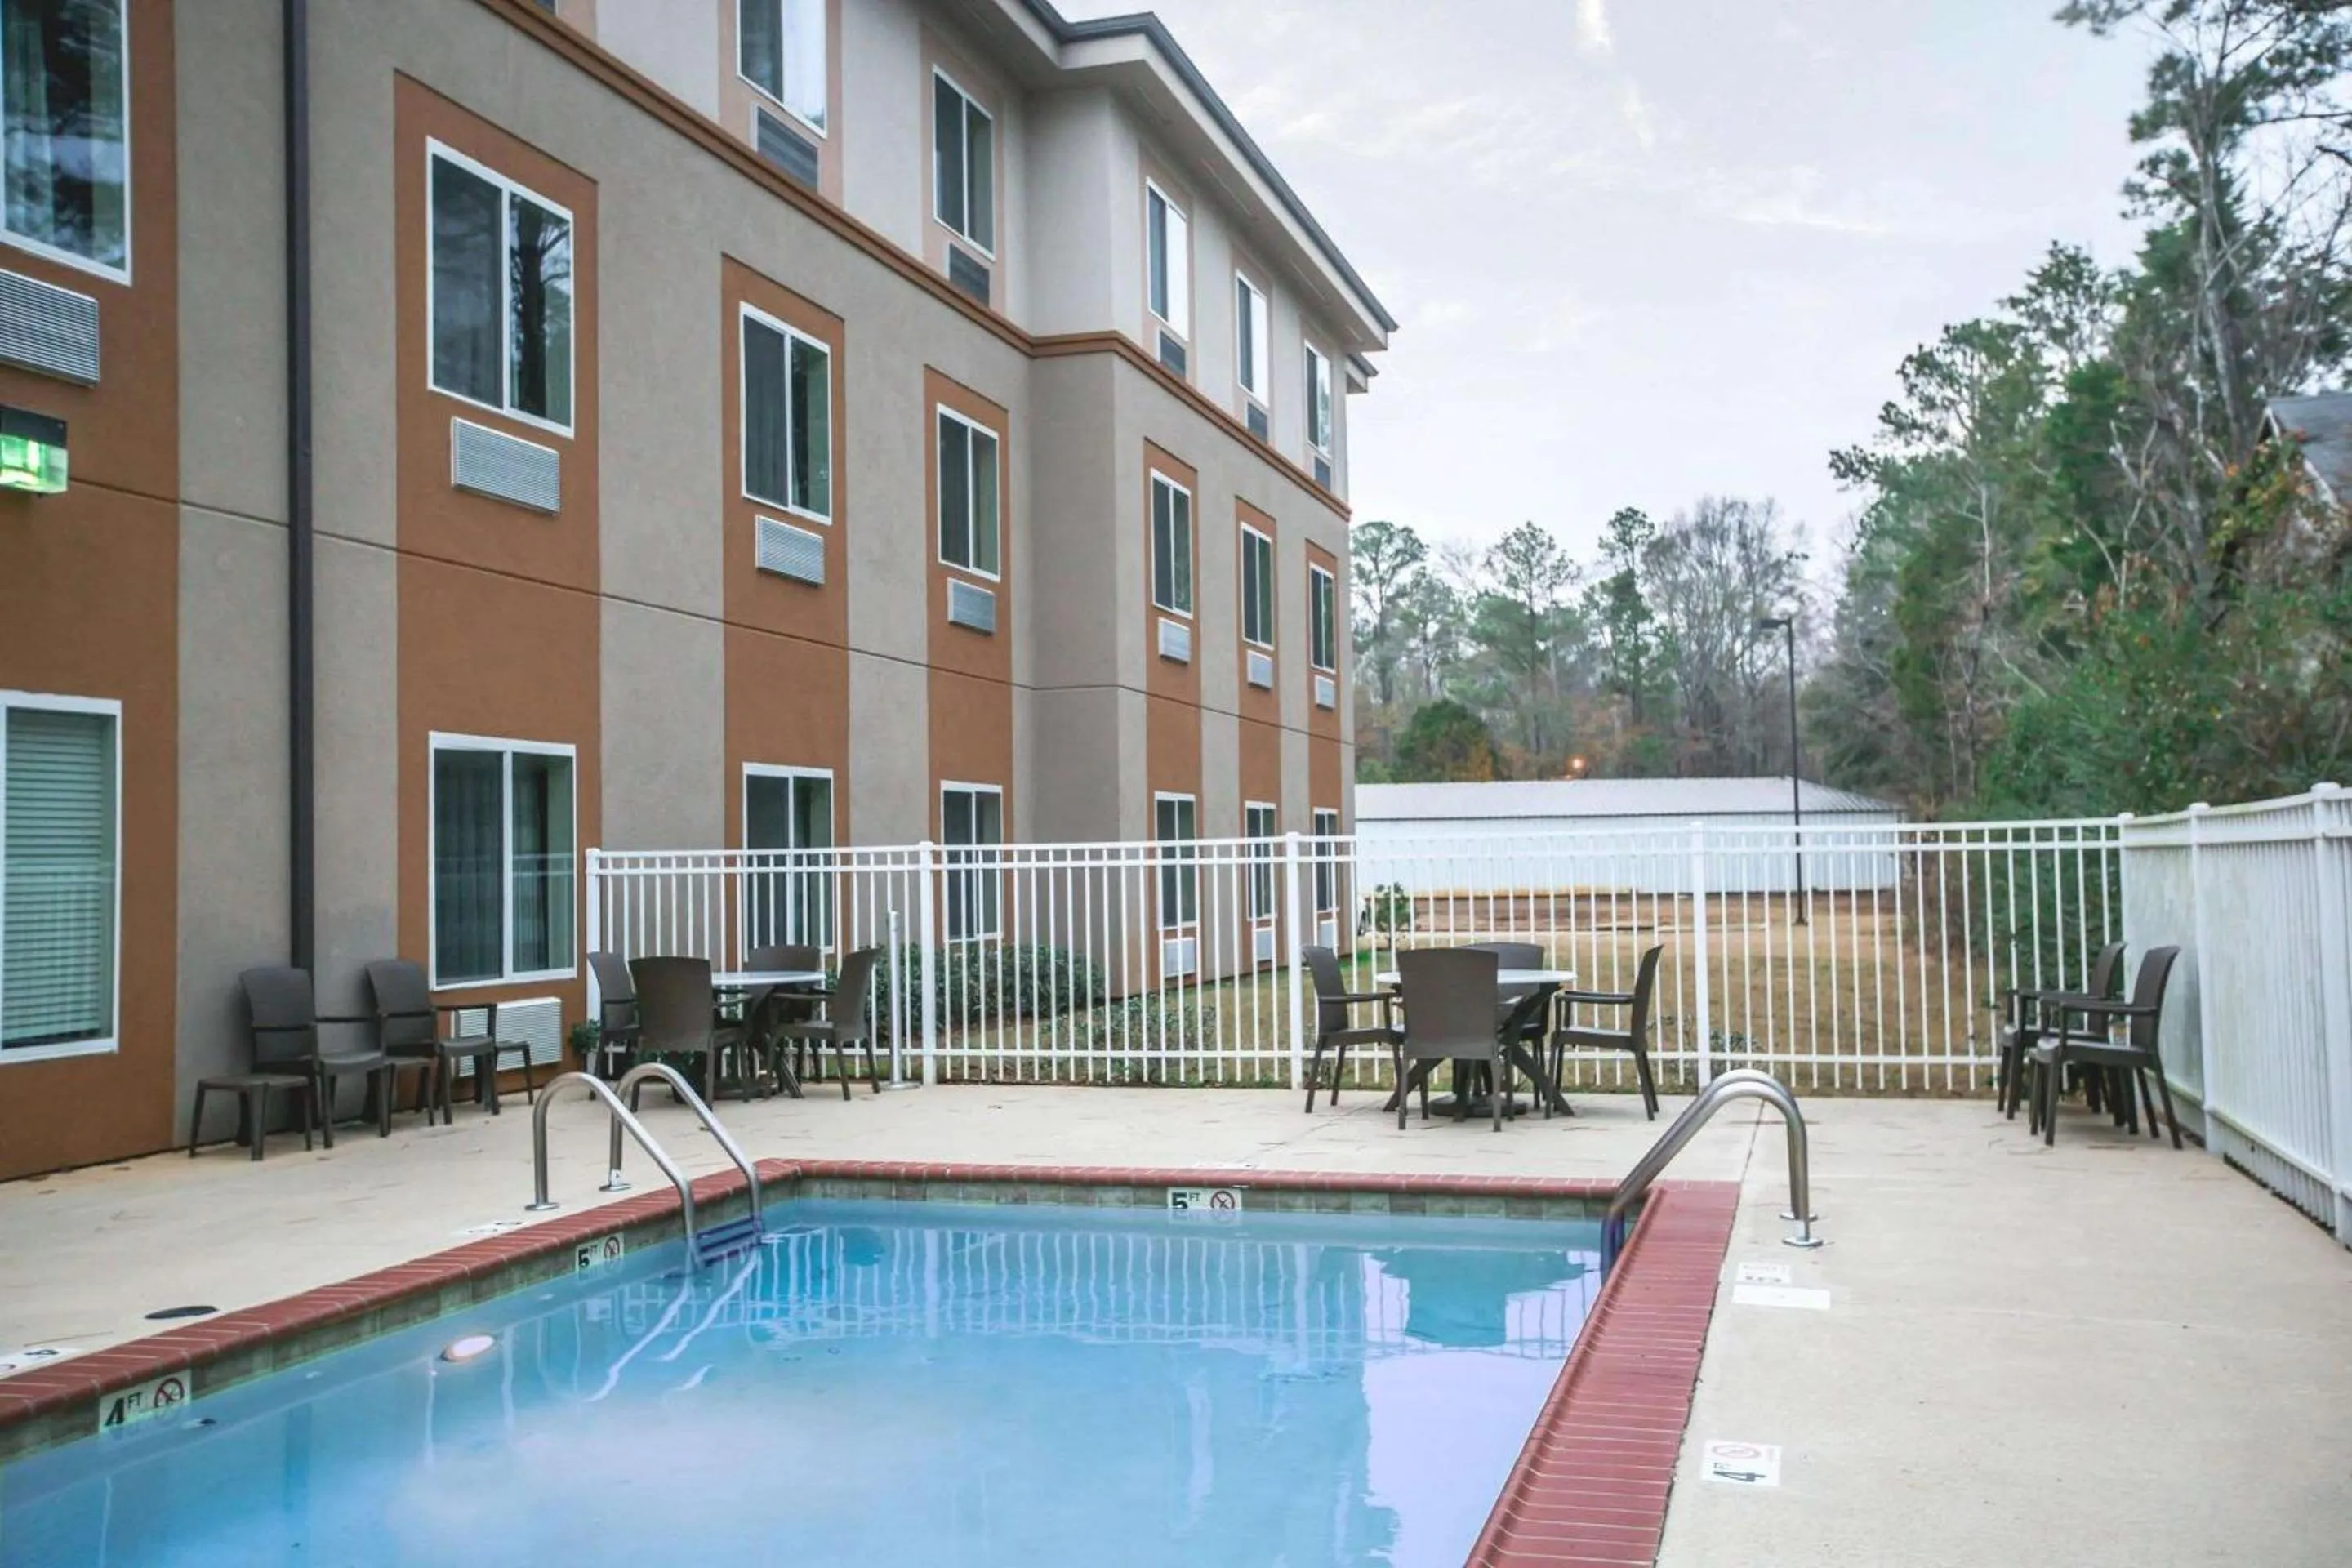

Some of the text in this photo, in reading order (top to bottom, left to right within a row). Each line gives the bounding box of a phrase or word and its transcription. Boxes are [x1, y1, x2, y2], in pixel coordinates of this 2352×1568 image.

[1172, 1192, 1200, 1209] 5 FT
[578, 1247, 590, 1267] 5
[104, 1391, 143, 1427] 4 FT
[1713, 1470, 1766, 1483] 4
